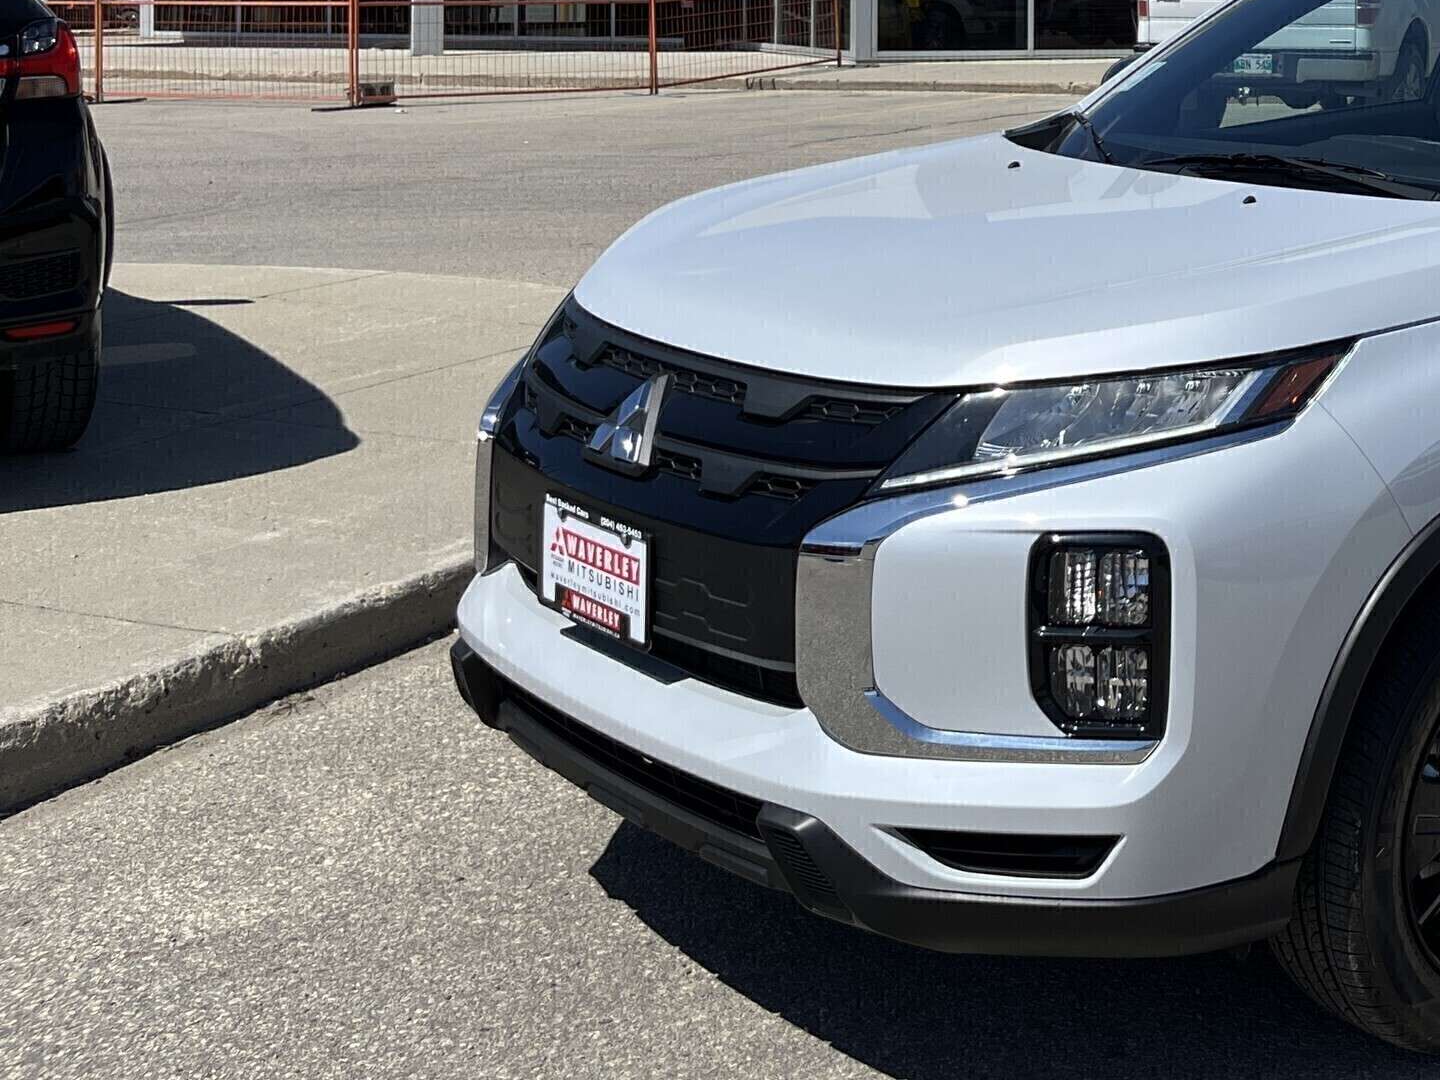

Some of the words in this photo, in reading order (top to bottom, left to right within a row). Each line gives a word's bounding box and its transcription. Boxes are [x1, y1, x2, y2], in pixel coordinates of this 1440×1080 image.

[567, 532, 640, 582] WAVERLEY
[568, 560, 640, 602] MITSUBISHI
[572, 594, 620, 628] WAVERLEY
